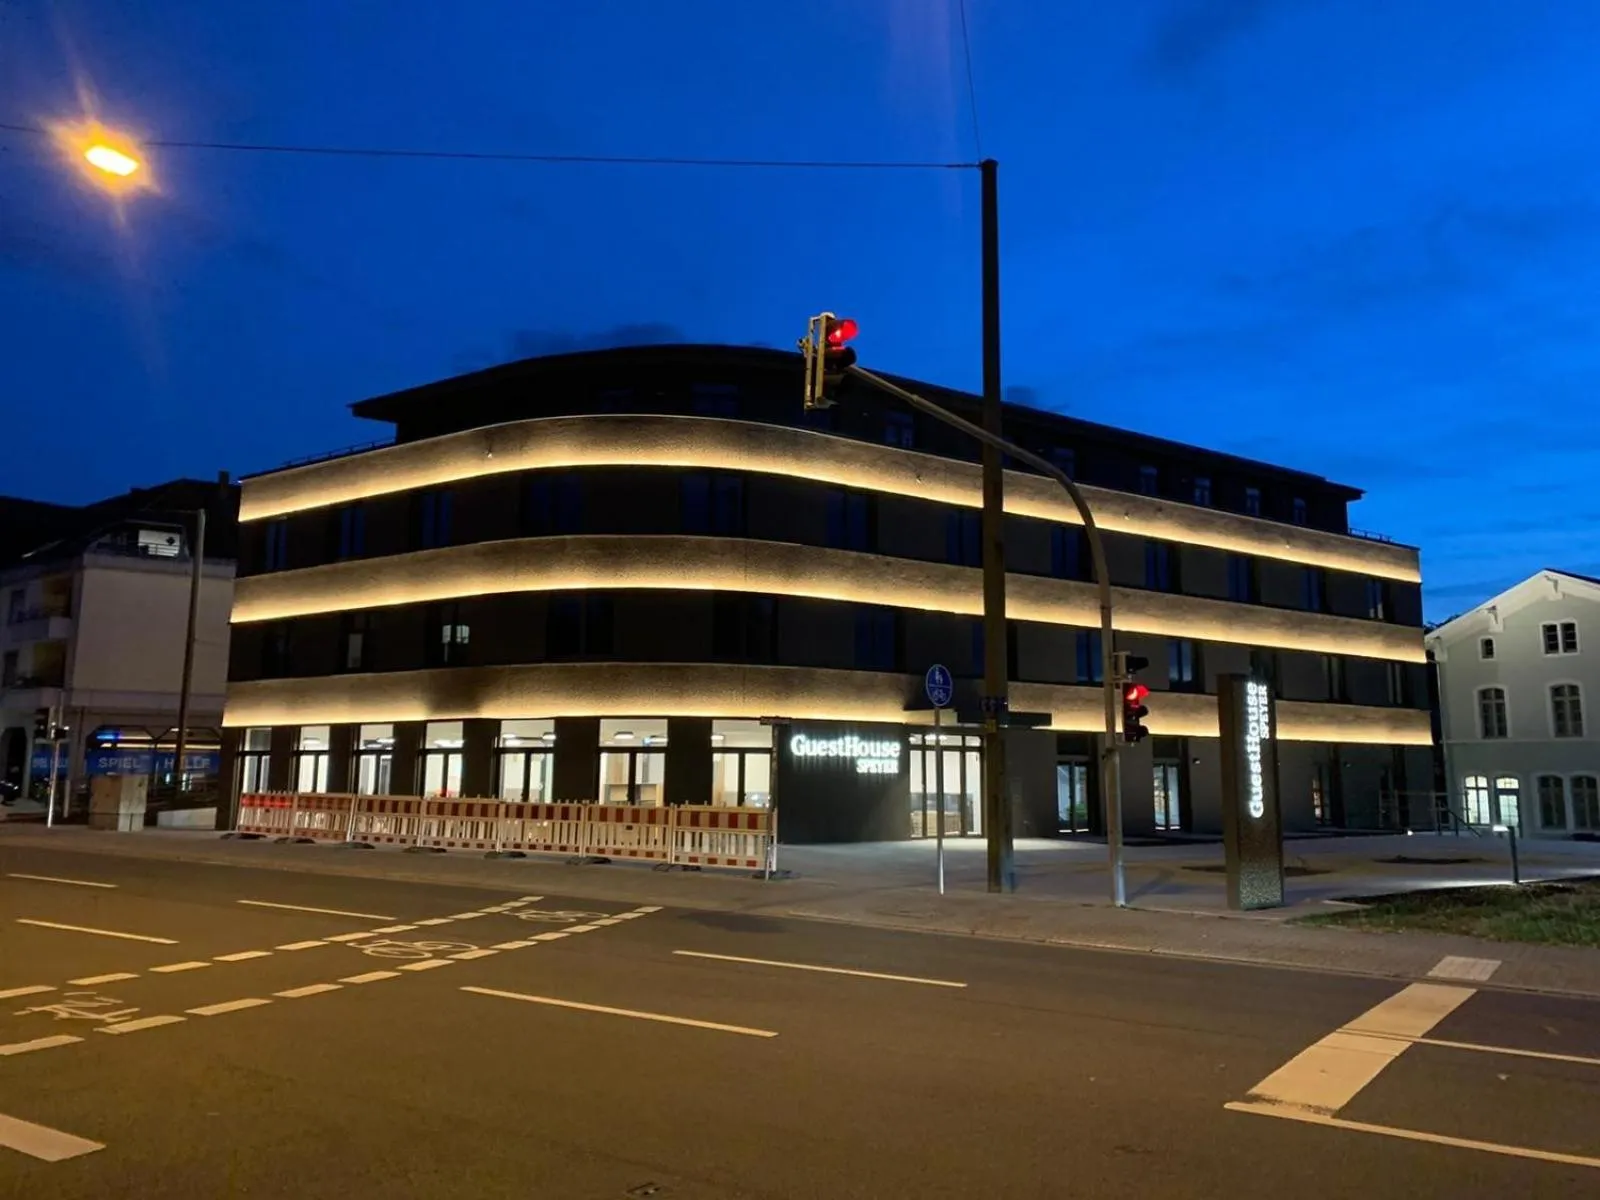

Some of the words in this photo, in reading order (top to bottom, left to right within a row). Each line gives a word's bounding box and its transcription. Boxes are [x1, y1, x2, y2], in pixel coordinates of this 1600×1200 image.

[790, 734, 901, 757] GuestHouse
[1246, 682, 1263, 818] GuestHouse
[164, 757, 210, 769] HLLE
